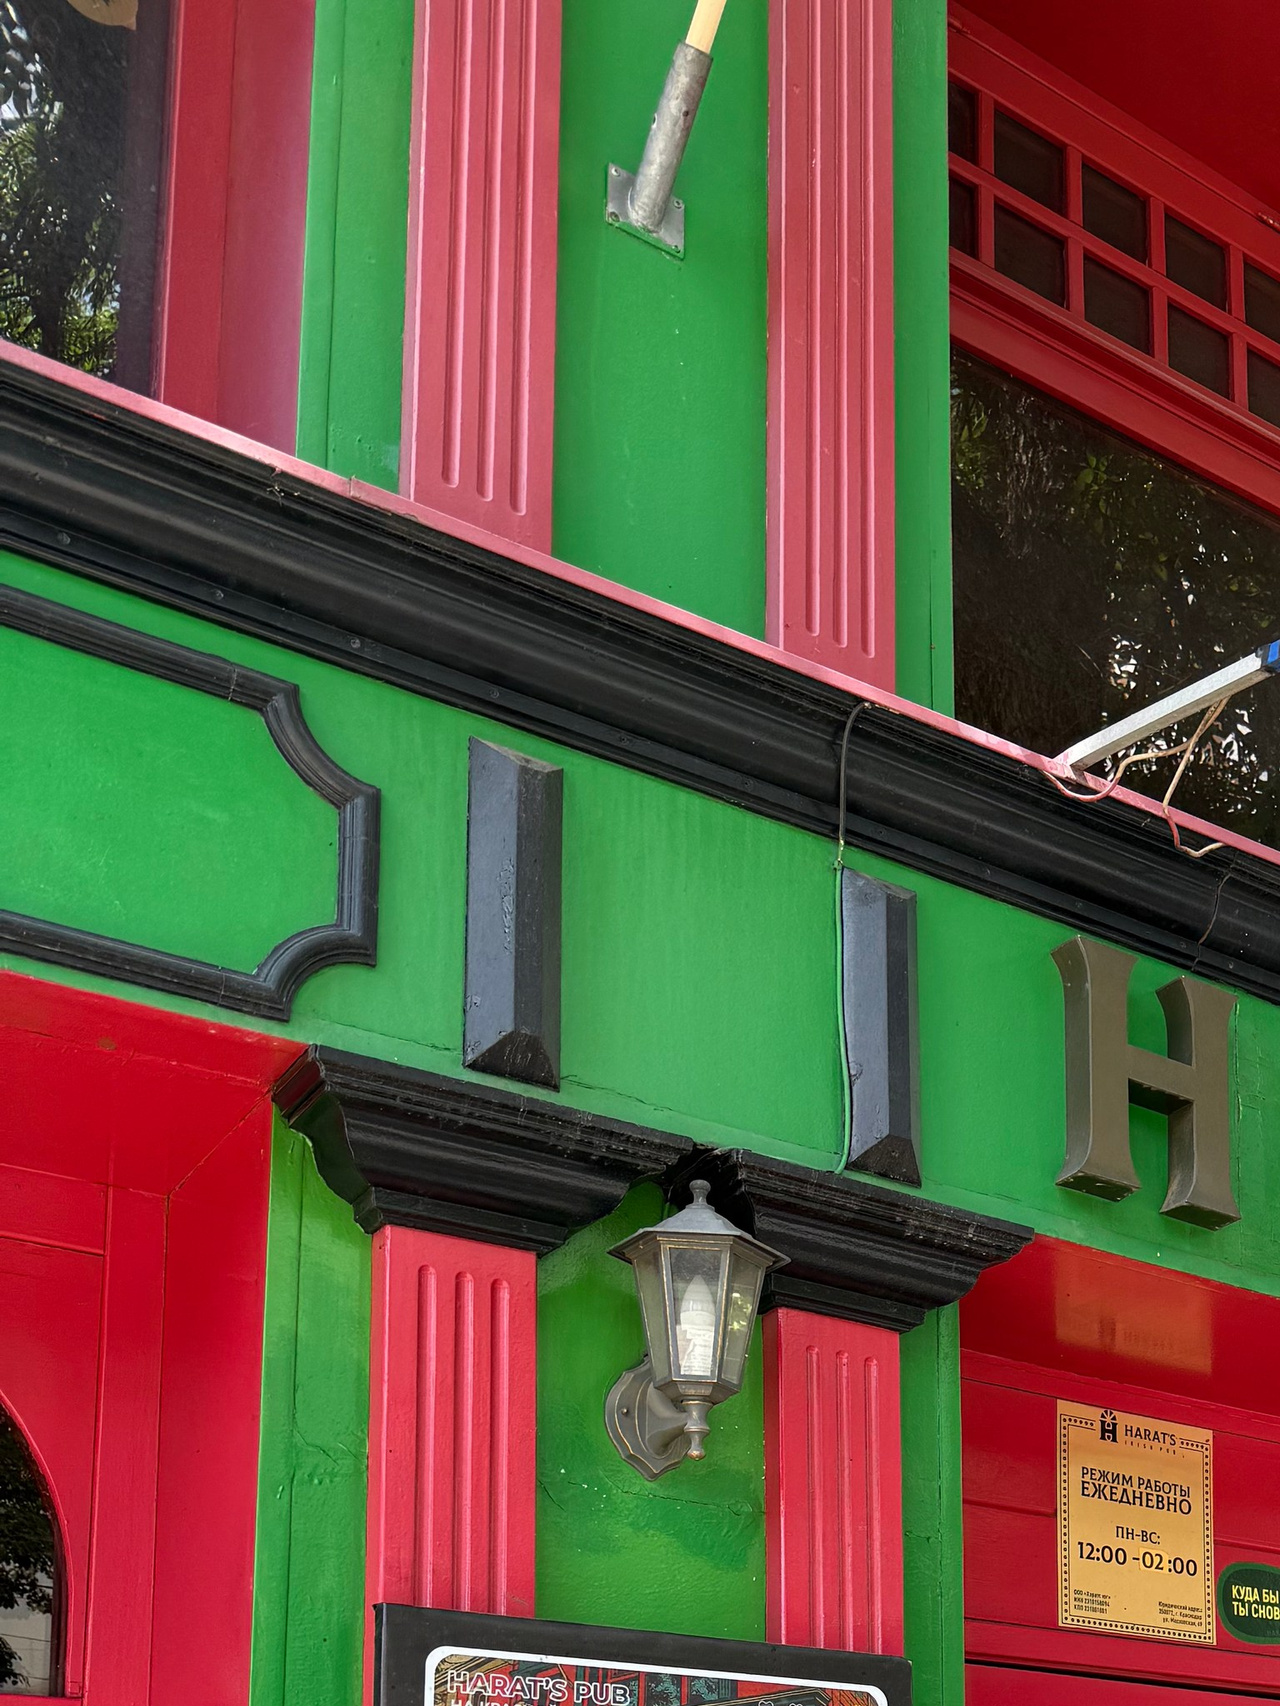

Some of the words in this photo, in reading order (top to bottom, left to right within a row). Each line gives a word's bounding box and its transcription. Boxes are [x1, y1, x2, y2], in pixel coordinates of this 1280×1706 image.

[1124, 1424, 1177, 1446] HARAT'S
[1081, 1466, 1133, 1487] РЕЖИМ
[1137, 1476, 1190, 1498] РАБОТЫ
[1081, 1480, 1192, 1515] ЕЖЕДНЕВНО
[1115, 1525, 1160, 1545] ПН-ВС:
[1077, 1541, 1127, 1565] 12:00
[1231, 1585, 1260, 1602] КУДА
[1262, 1589, 1279, 1604] БЫ
[1232, 1602, 1249, 1616] ТЫ
[447, 1669, 568, 1702] HARAT'S
[573, 1680, 631, 1706] PUB
